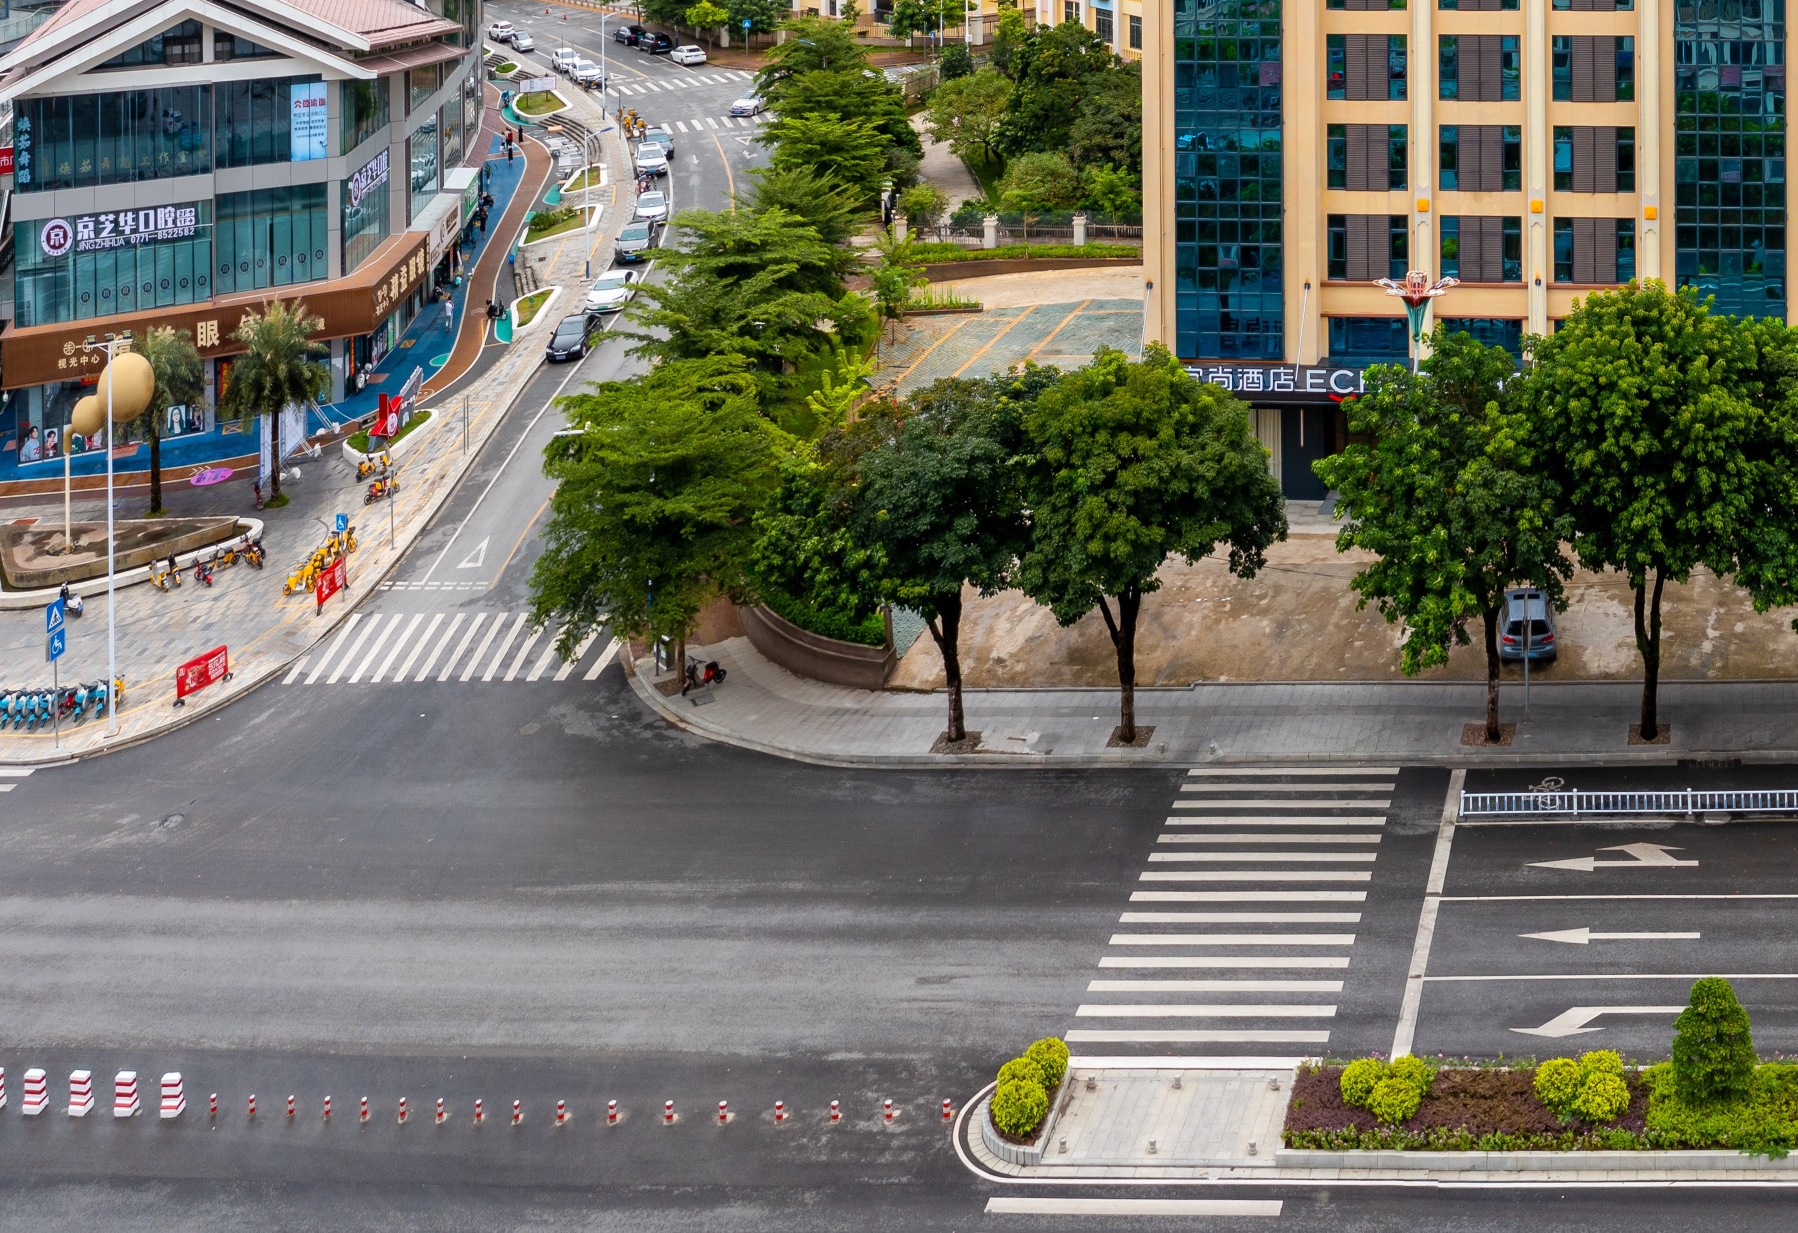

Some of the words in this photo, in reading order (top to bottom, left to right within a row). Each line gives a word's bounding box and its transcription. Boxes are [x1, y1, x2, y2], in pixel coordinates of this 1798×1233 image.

[76, 206, 176, 241] 京芝华口腔
[58, 353, 101, 370] 视光中心
